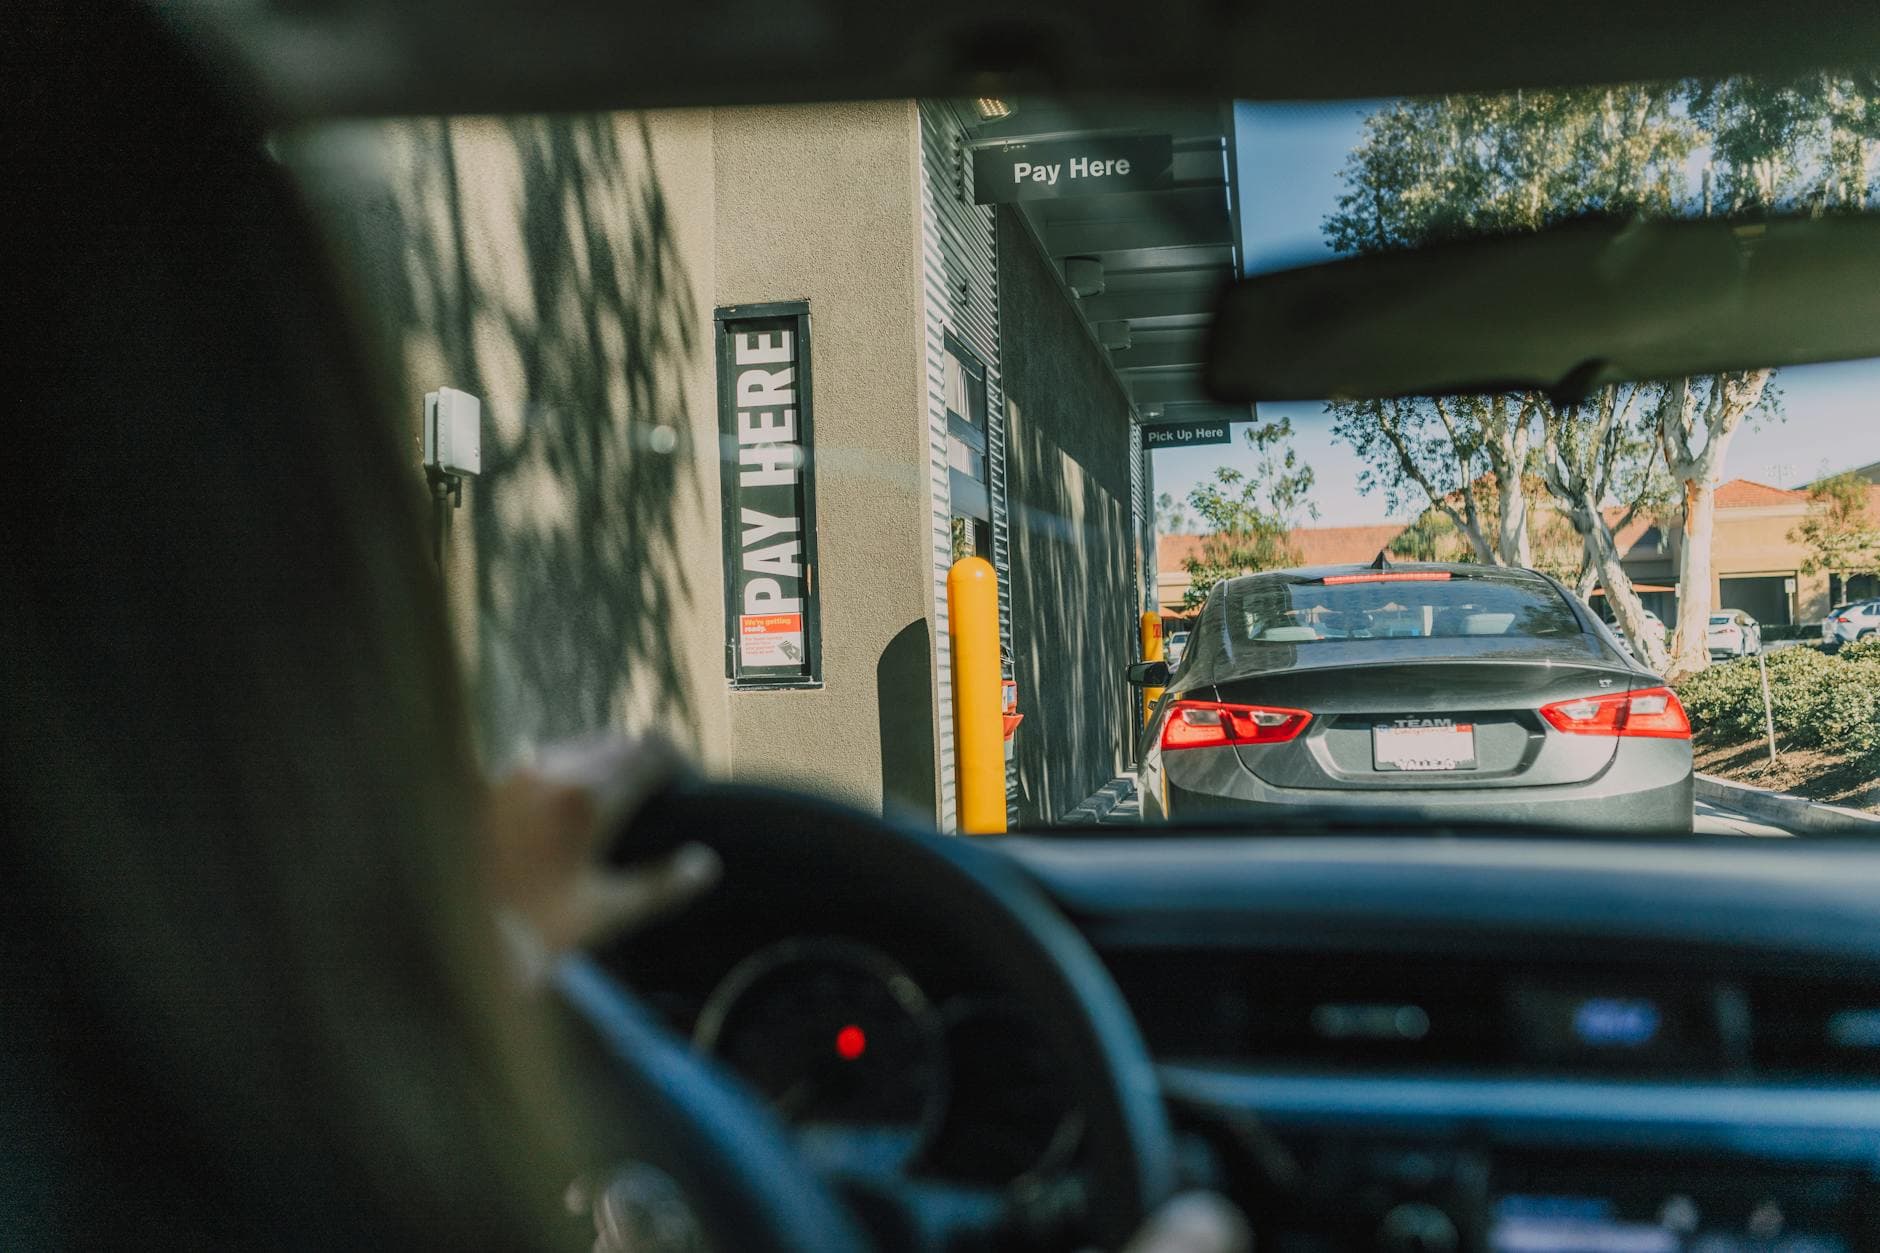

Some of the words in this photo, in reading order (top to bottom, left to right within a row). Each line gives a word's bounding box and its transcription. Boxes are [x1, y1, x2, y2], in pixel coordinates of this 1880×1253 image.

[1014, 162, 1061, 185] Pay
[1069, 157, 1130, 178] Here
[735, 330, 799, 488] HERE
[1148, 431, 1173, 442] Pick
[1176, 430, 1193, 440] Up
[1196, 428, 1223, 438] Here
[741, 508, 804, 614] PAY
[1394, 718, 1452, 728] TEAM
